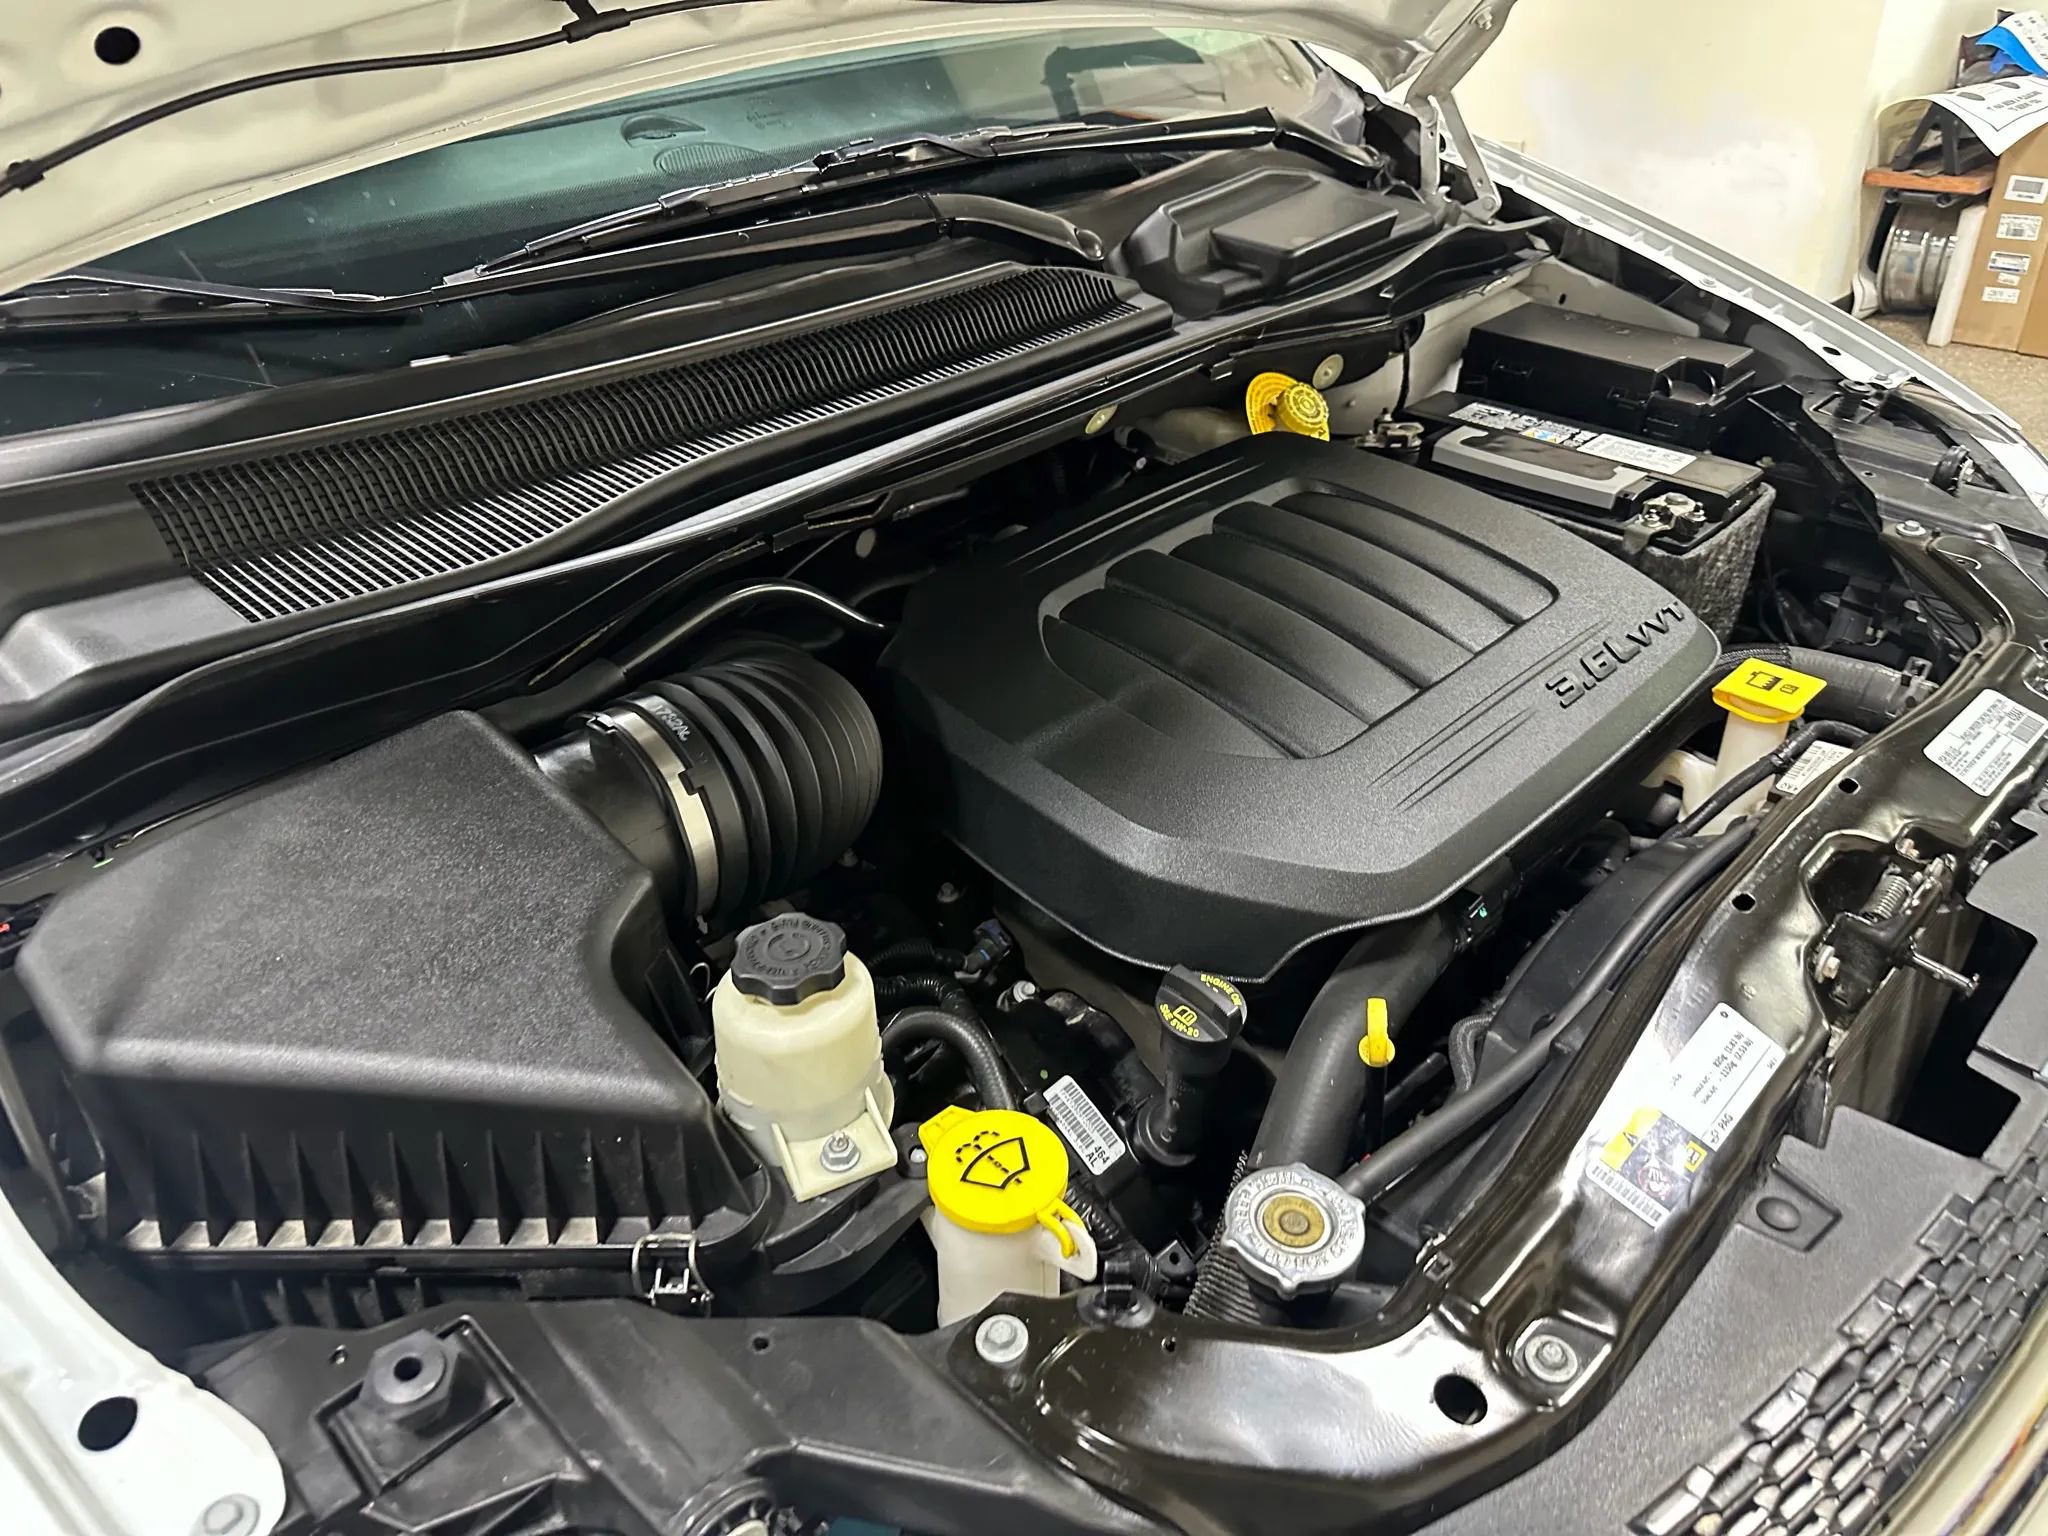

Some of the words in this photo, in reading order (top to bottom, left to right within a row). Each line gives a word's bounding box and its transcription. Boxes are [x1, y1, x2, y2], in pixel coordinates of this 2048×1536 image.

[1200, 973, 1234, 995] ENGINE
[1160, 1003, 1174, 1021] SAE
[1170, 1018, 1200, 1038] 5W-20
[1085, 1151, 1098, 1168] AL
[1094, 1146, 1110, 1165] 464
